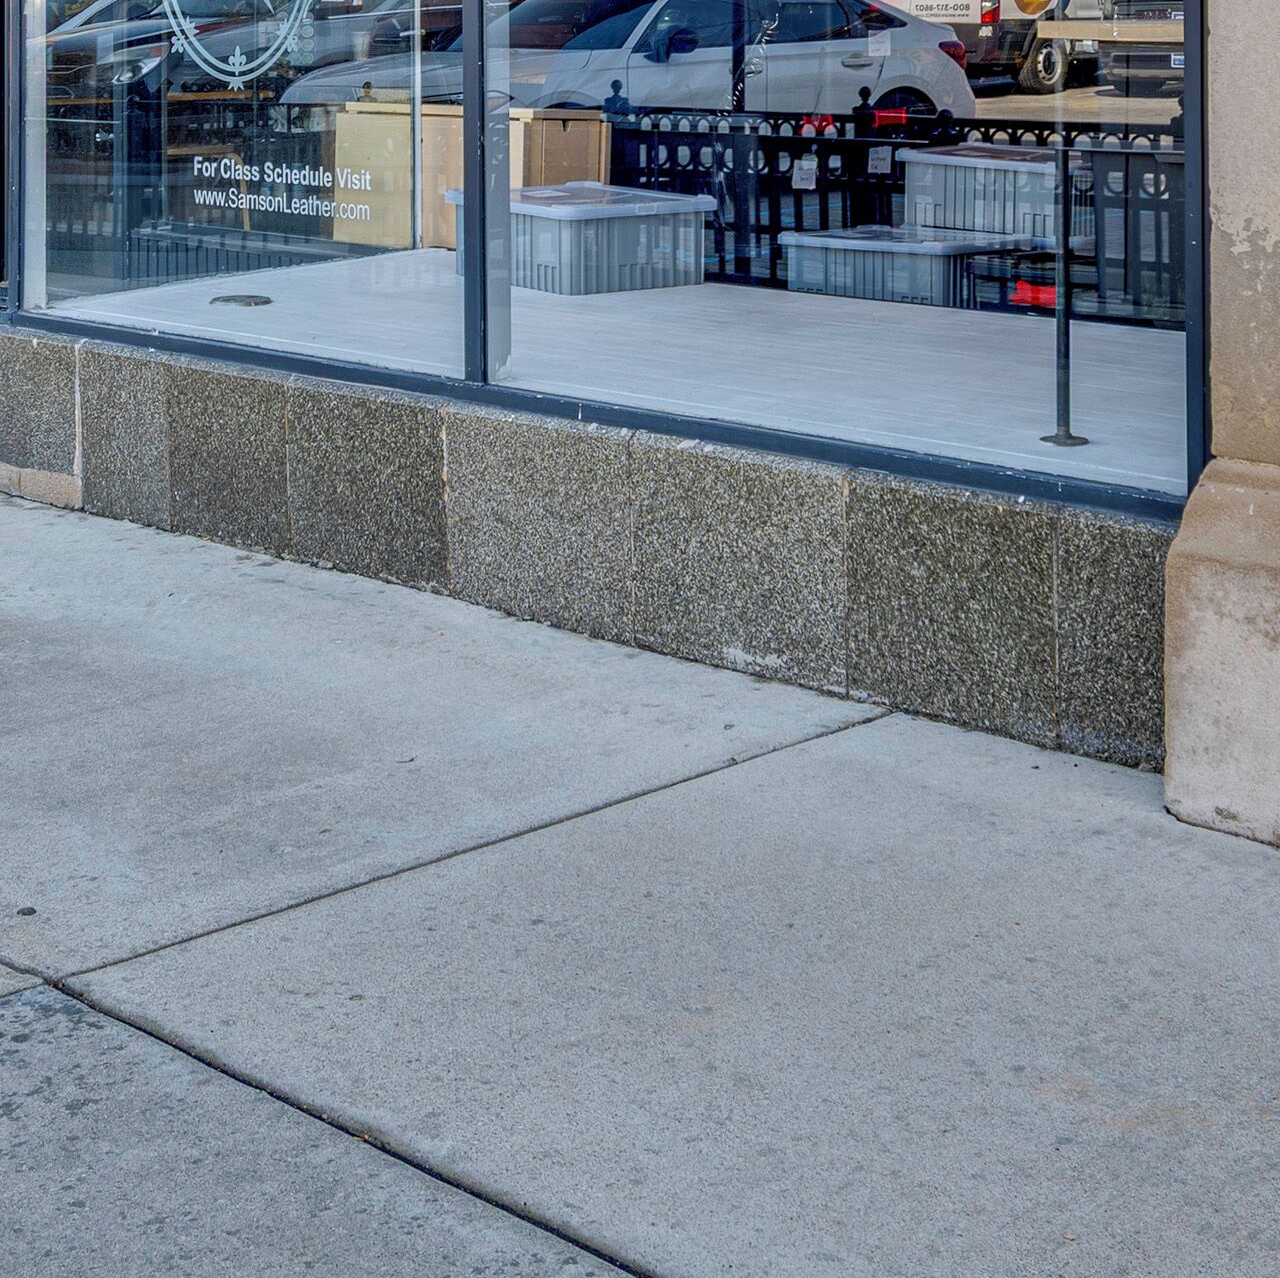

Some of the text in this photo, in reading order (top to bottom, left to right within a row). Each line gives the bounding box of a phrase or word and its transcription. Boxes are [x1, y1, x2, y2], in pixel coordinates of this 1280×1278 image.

[193, 155, 372, 191] For Class Schedule Visit
[193, 188, 370, 221] www.SamsonLeather.com
